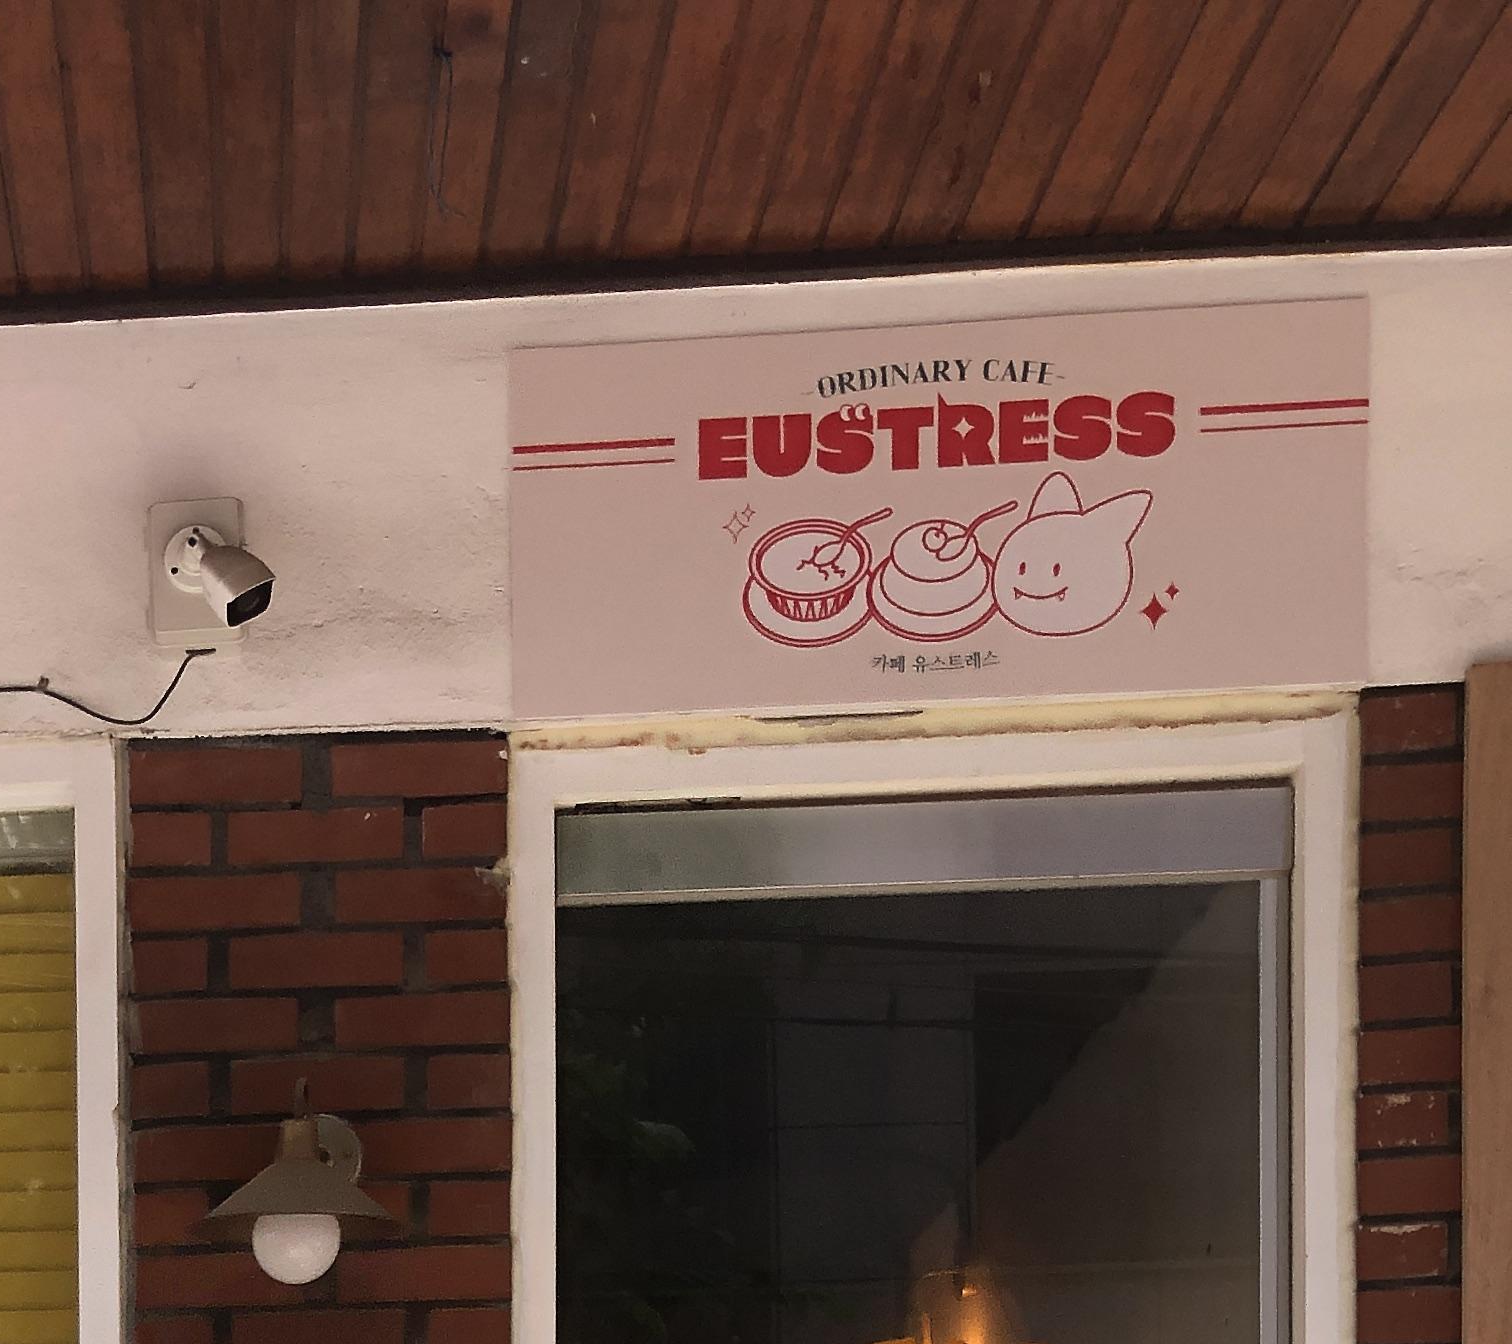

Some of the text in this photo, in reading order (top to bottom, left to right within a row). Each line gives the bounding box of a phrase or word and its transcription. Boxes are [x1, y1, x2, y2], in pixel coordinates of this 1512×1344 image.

[817, 358, 1056, 398] ORDINARY CAFE
[697, 391, 1177, 480] EUSTRESS
[872, 650, 1001, 674] 카페 유스트레스
